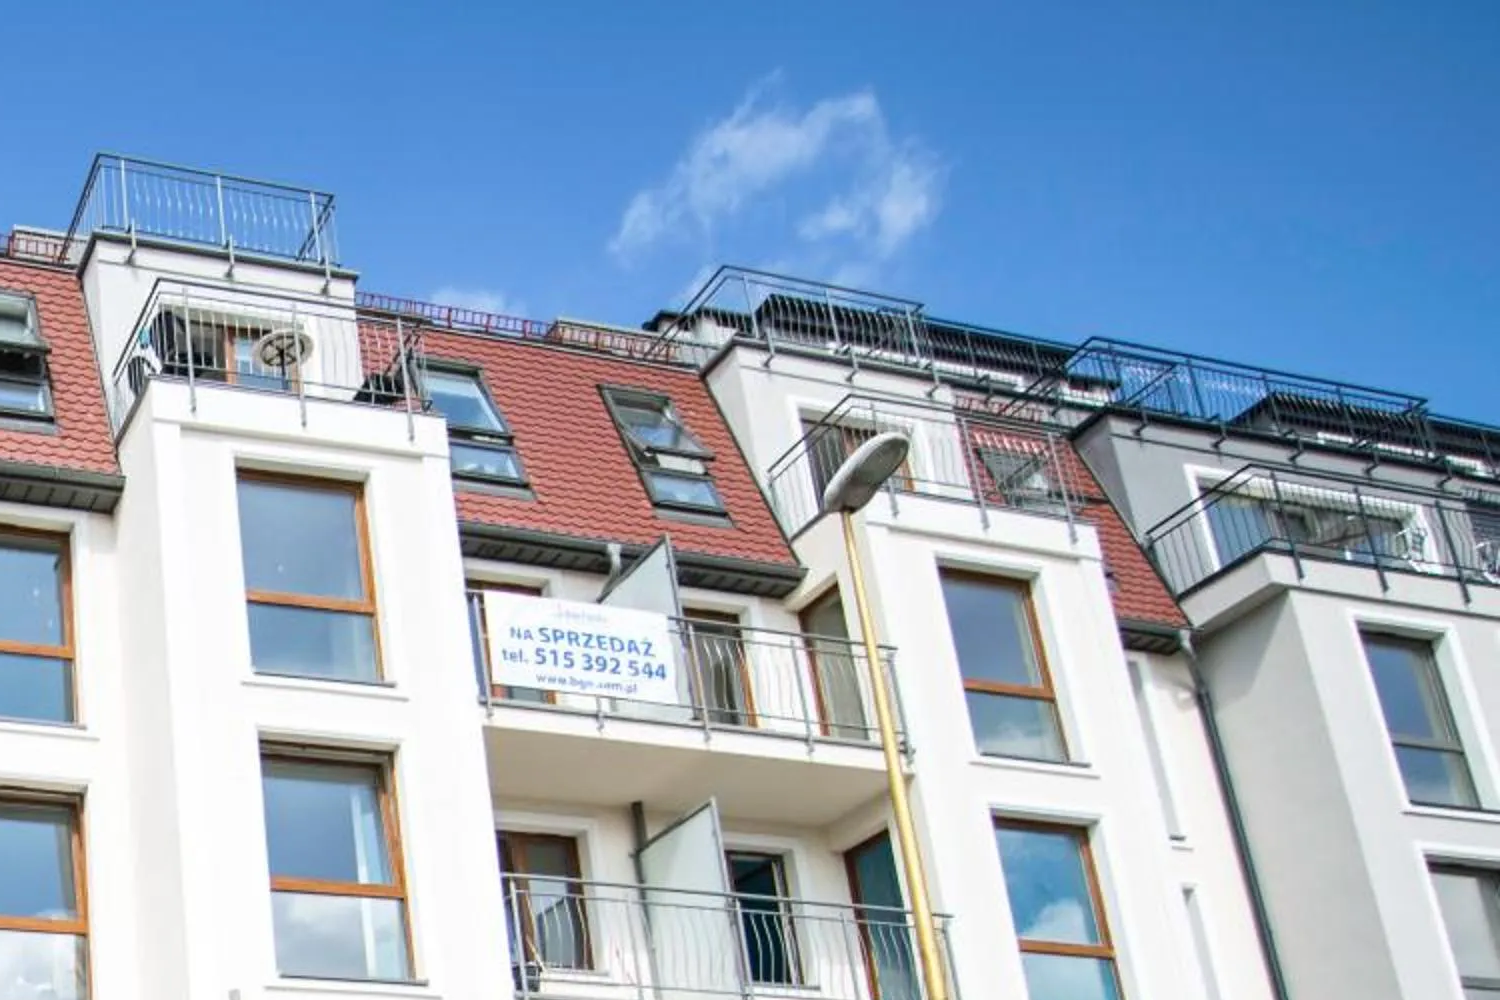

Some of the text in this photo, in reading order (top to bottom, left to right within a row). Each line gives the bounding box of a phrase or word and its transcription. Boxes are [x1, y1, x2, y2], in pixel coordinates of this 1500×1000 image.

[510, 627, 655, 657] NA SPRZEDAŻ
[535, 648, 575, 669] 515
[582, 653, 621, 675] 392
[627, 660, 666, 681] 544
